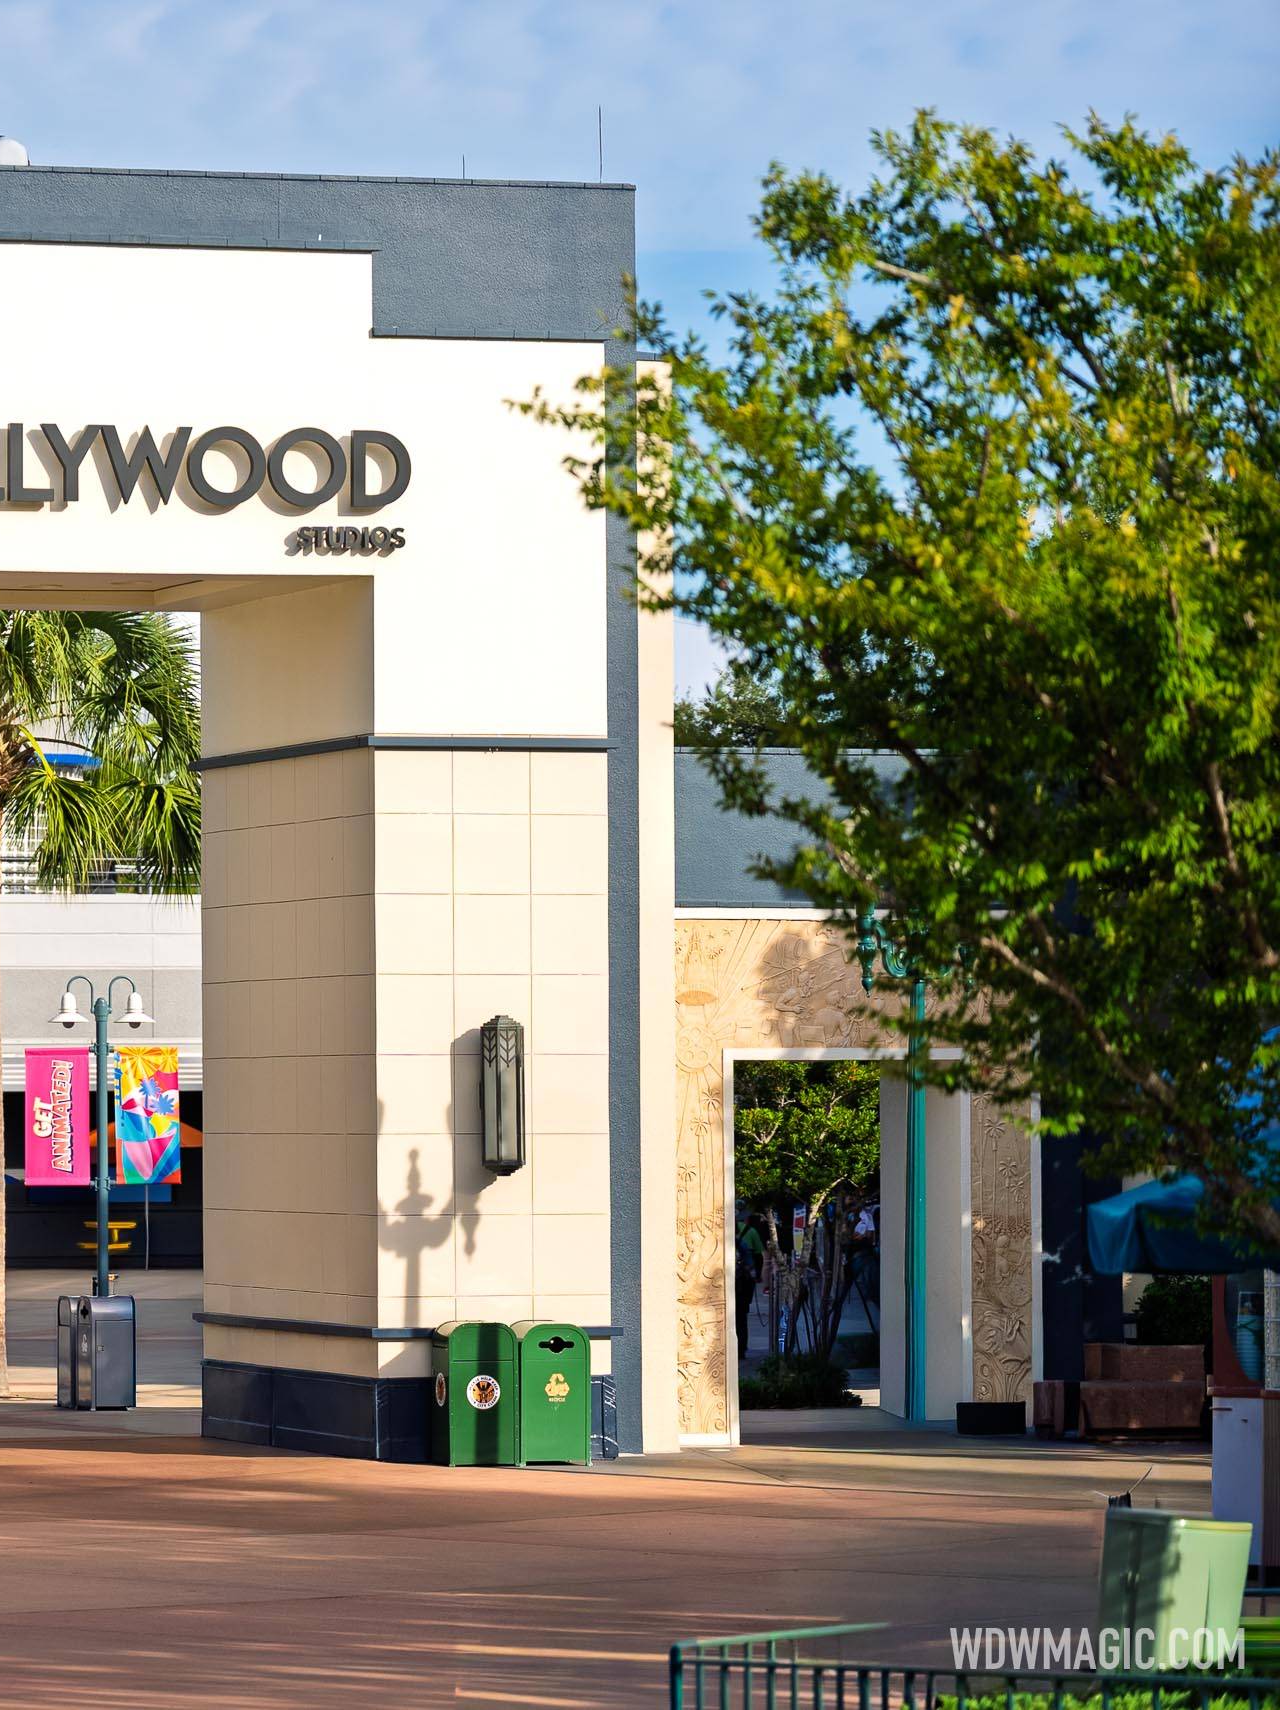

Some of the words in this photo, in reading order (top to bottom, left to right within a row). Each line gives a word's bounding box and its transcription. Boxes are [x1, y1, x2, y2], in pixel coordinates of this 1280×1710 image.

[296, 526, 406, 549] STUDIOS
[32, 1096, 53, 1138] GET
[51, 1059, 74, 1173] ANIMATED!
